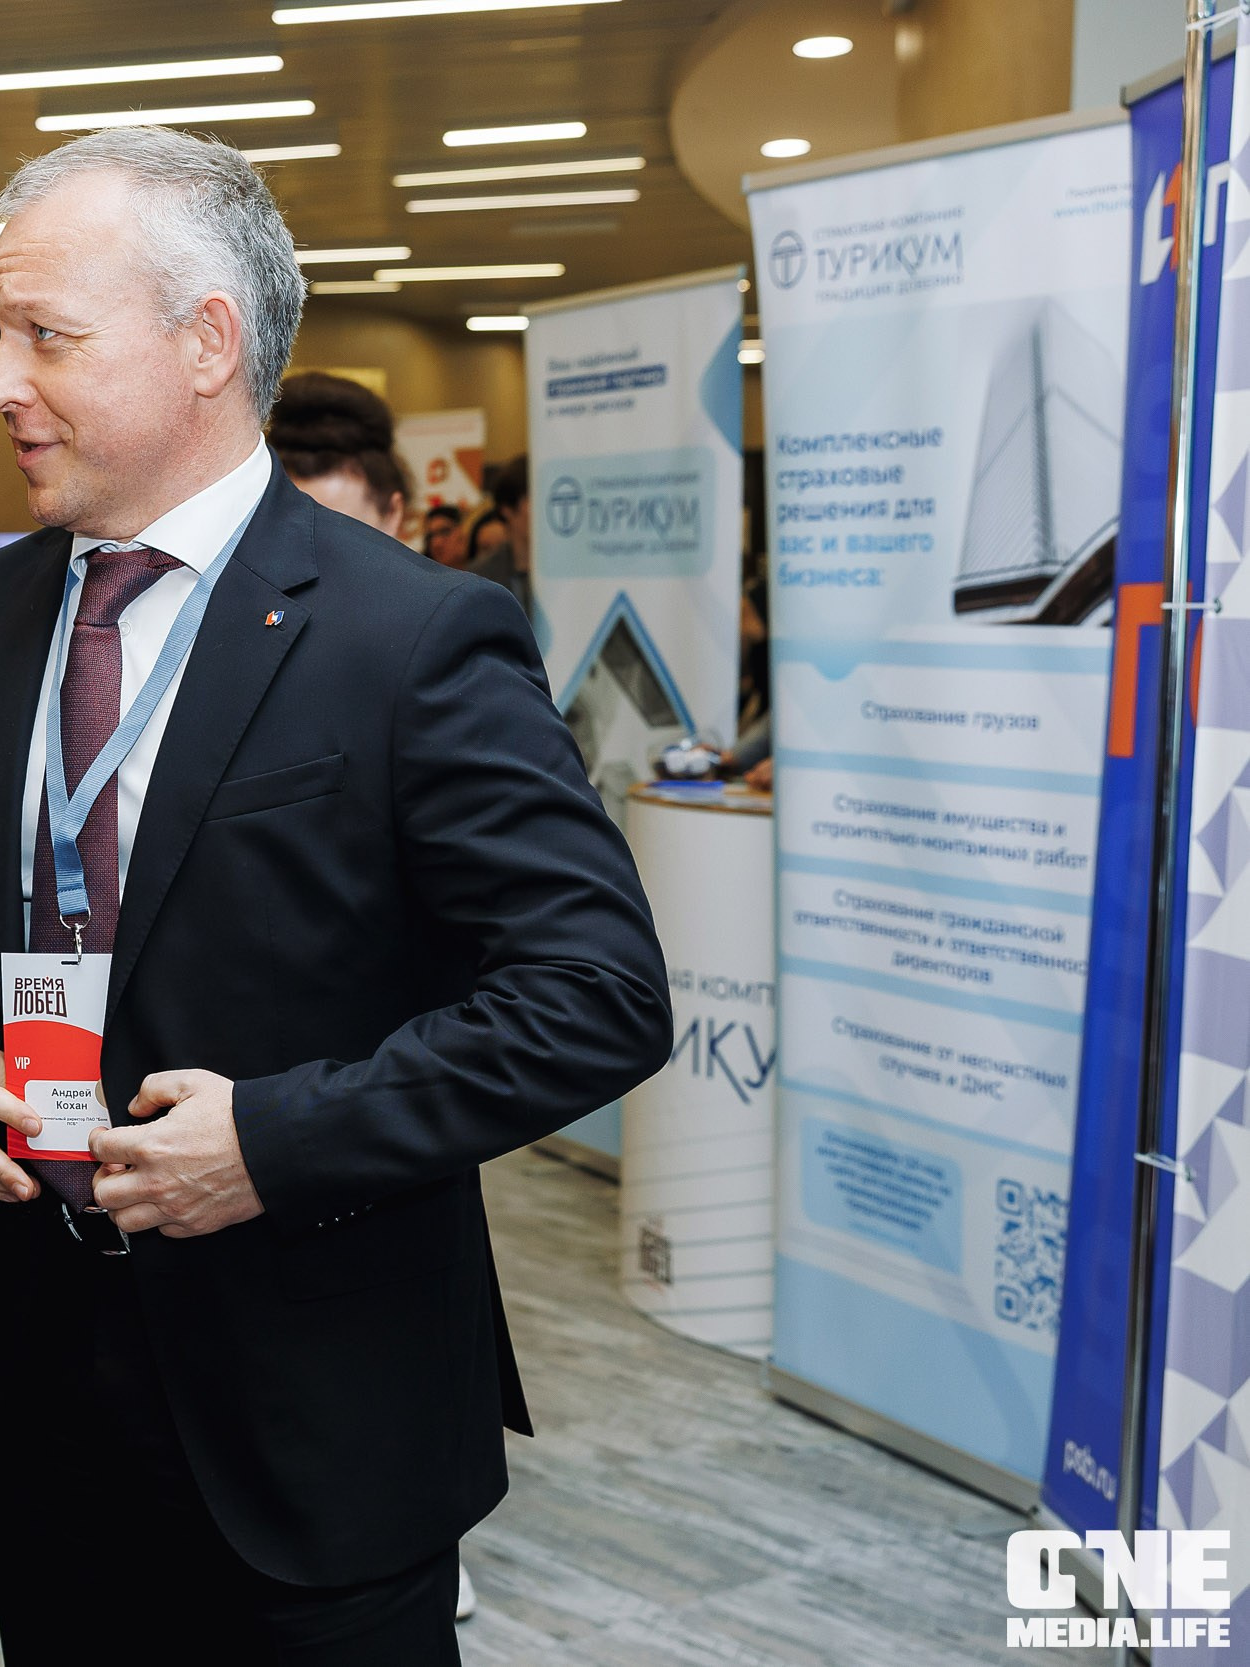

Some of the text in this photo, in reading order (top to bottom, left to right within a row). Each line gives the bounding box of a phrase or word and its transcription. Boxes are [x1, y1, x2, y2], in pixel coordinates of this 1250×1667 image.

[814, 230, 964, 281] ТУРИКУМ
[777, 427, 943, 455] Комплексные
[777, 465, 904, 493] страховые
[777, 498, 936, 525] решения для
[778, 532, 934, 553] вас и вашего
[860, 700, 1040, 732] Страхование грузов
[834, 793, 1067, 837] Страхование имущества и
[1034, 846, 1087, 869] работ
[833, 889, 1066, 944] Страхование гражданской
[893, 951, 993, 983] директоров
[14, 977, 65, 990] ВРЕМЯ
[13, 990, 68, 1017] ПОБЕД
[14, 1056, 31, 1070] VIP
[831, 1015, 1068, 1090] Страхование от несчастных
[879, 1053, 941, 1084] случаев
[51, 1088, 92, 1099] Андрей
[56, 1100, 88, 1110] Кохан
